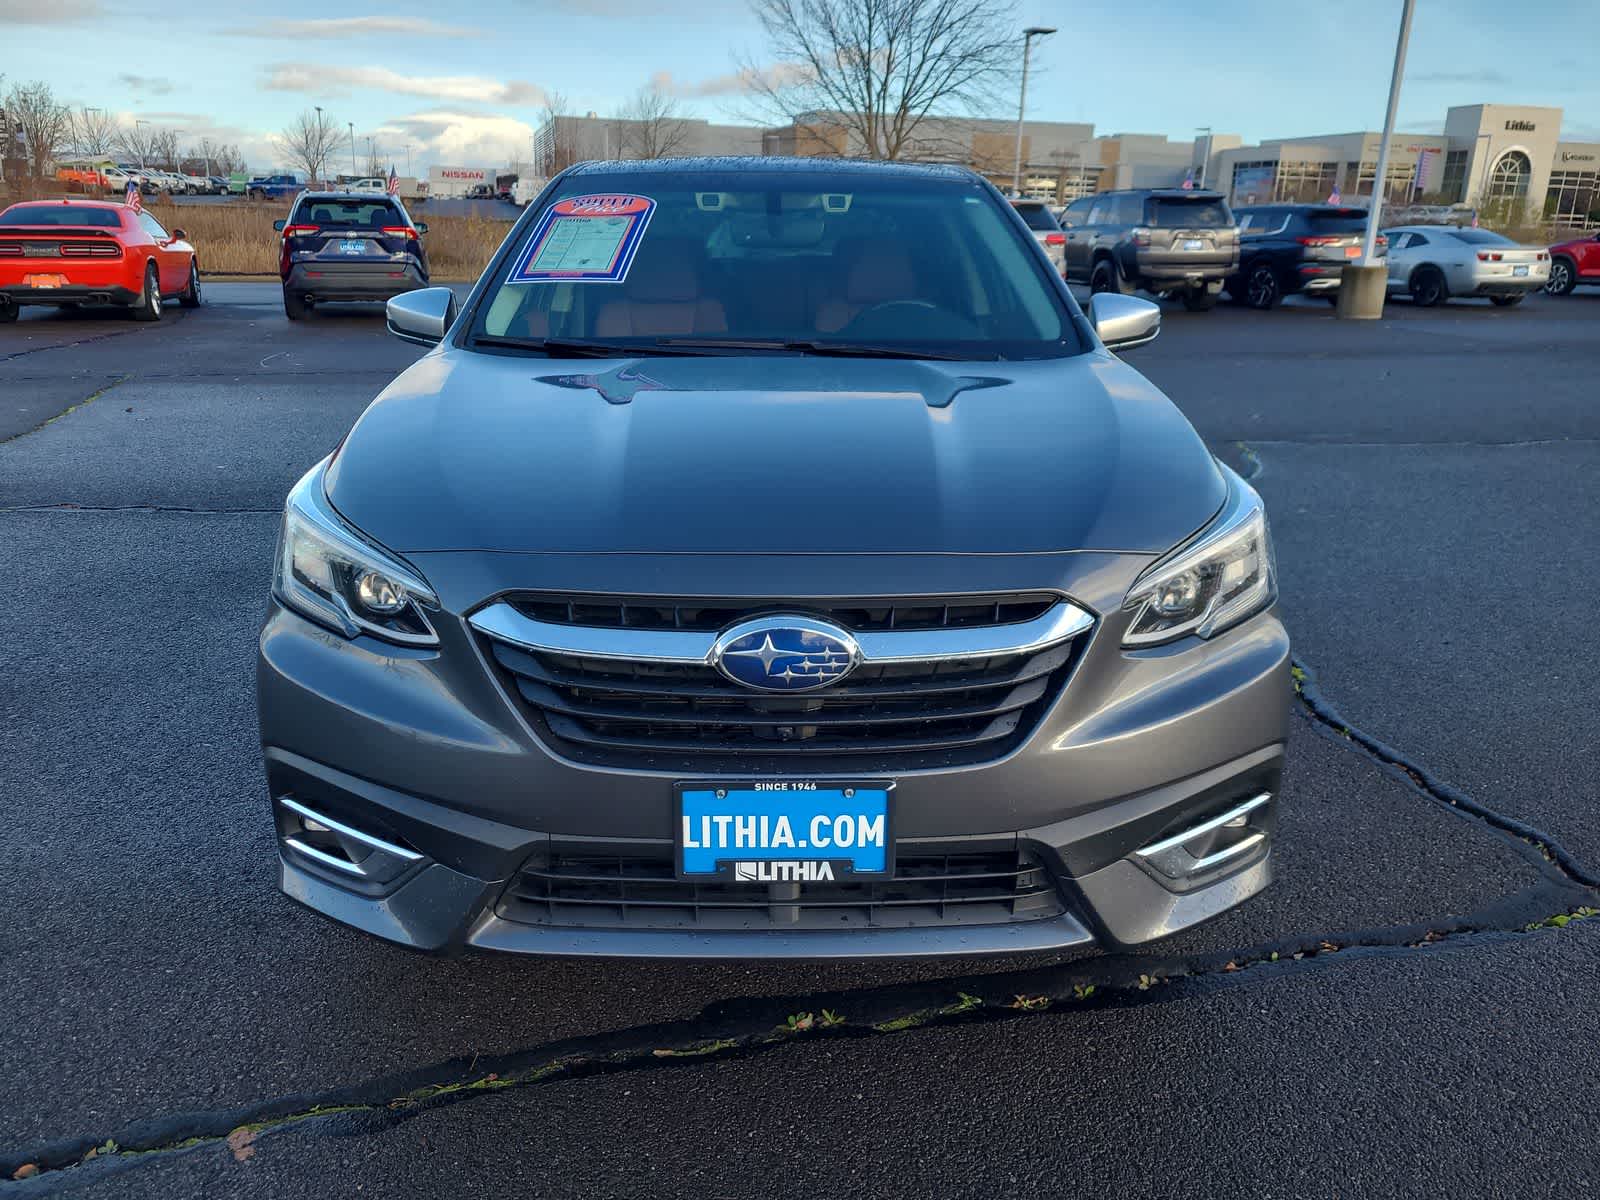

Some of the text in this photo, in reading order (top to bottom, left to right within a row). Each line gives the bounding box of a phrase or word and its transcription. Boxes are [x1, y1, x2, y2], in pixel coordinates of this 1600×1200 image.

[1505, 120, 1535, 131] Lithia
[441, 170, 484, 179] NISSAN
[754, 783, 817, 791] SINCE 1946
[682, 814, 885, 848] LITHIA.COM
[757, 861, 834, 881] LITHIA
